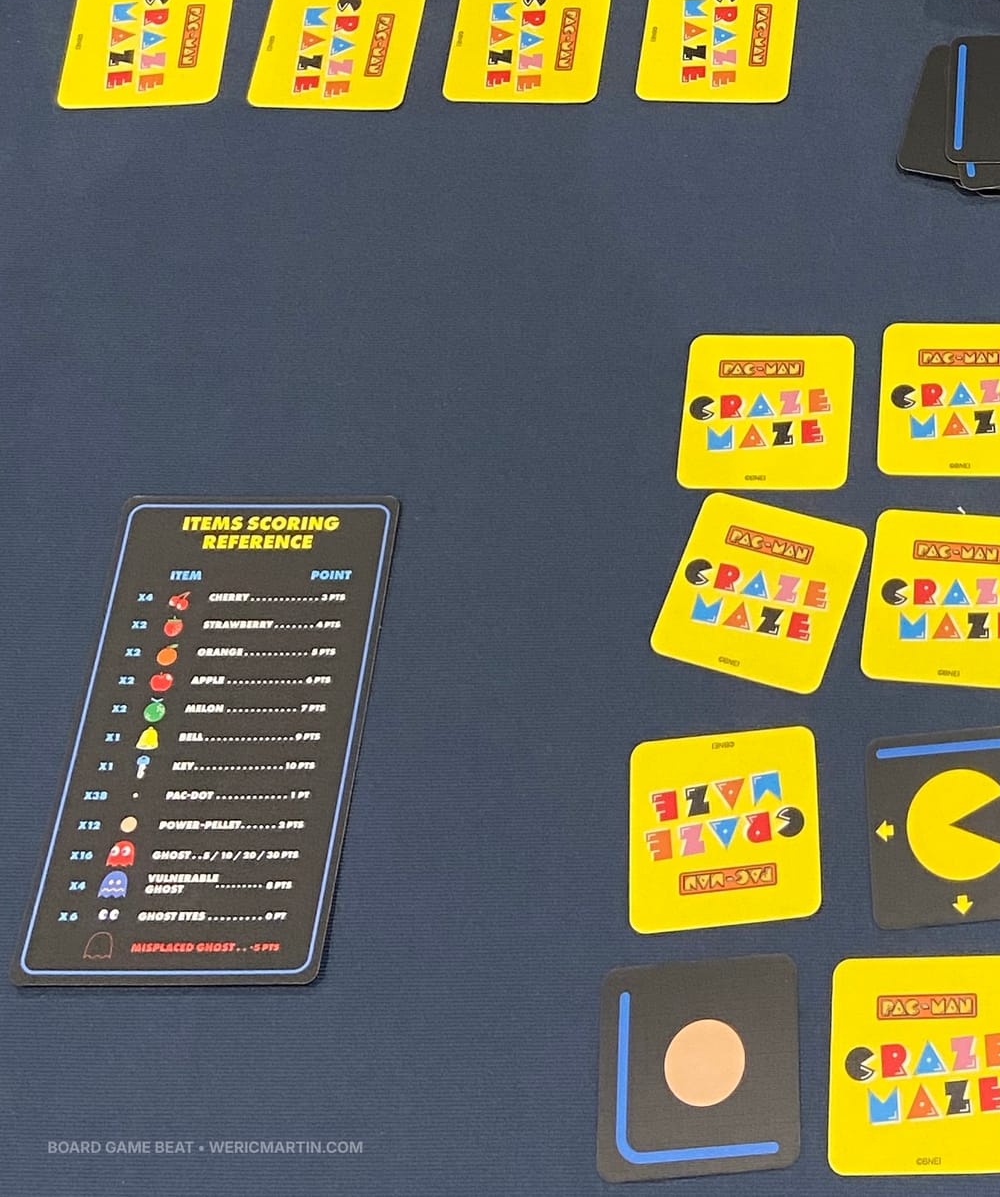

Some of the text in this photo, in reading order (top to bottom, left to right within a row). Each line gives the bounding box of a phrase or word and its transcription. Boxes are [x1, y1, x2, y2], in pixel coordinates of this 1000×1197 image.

[921, 350, 1000, 366] PAC-MAN
[182, 515, 340, 532] ITEMS SCORING
[202, 534, 314, 550] REFERENCE
[169, 570, 352, 580] ITEM POINT
[131, 621, 148, 629] X2
[125, 649, 141, 657] X2
[119, 676, 135, 685] X2
[191, 676, 225, 685] APPLE
[314, 676, 331, 684] PTS
[112, 704, 127, 713] X2
[185, 704, 224, 713] MELON
[308, 704, 326, 712] PTS
[105, 732, 120, 742] X1
[302, 732, 321, 741] PTS
[98, 762, 113, 771] X1
[297, 762, 315, 770] PTS
[84, 791, 108, 800] X38
[166, 791, 215, 800] PAC-DOT
[297, 791, 310, 799] PT
[651, 771, 783, 822] MAZE
[78, 821, 101, 830] X12
[286, 821, 304, 829] PTS
[645, 807, 804, 862] CRAZE
[70, 851, 93, 860] X16
[281, 851, 299, 859] PTS
[148, 874, 219, 883] VULNERABLE
[681, 865, 775, 893] PAC-MAN
[69, 881, 86, 890] X4
[145, 885, 184, 894] GHOST
[274, 881, 292, 889] PTS
[138, 912, 178, 921] GHOST
[178, 912, 206, 921] EYES
[273, 912, 287, 921] PT
[131, 943, 195, 952] MISPLACED
[197, 943, 235, 952] GHOST
[262, 943, 280, 951] PTS
[879, 995, 975, 1018] PAC-MAN
